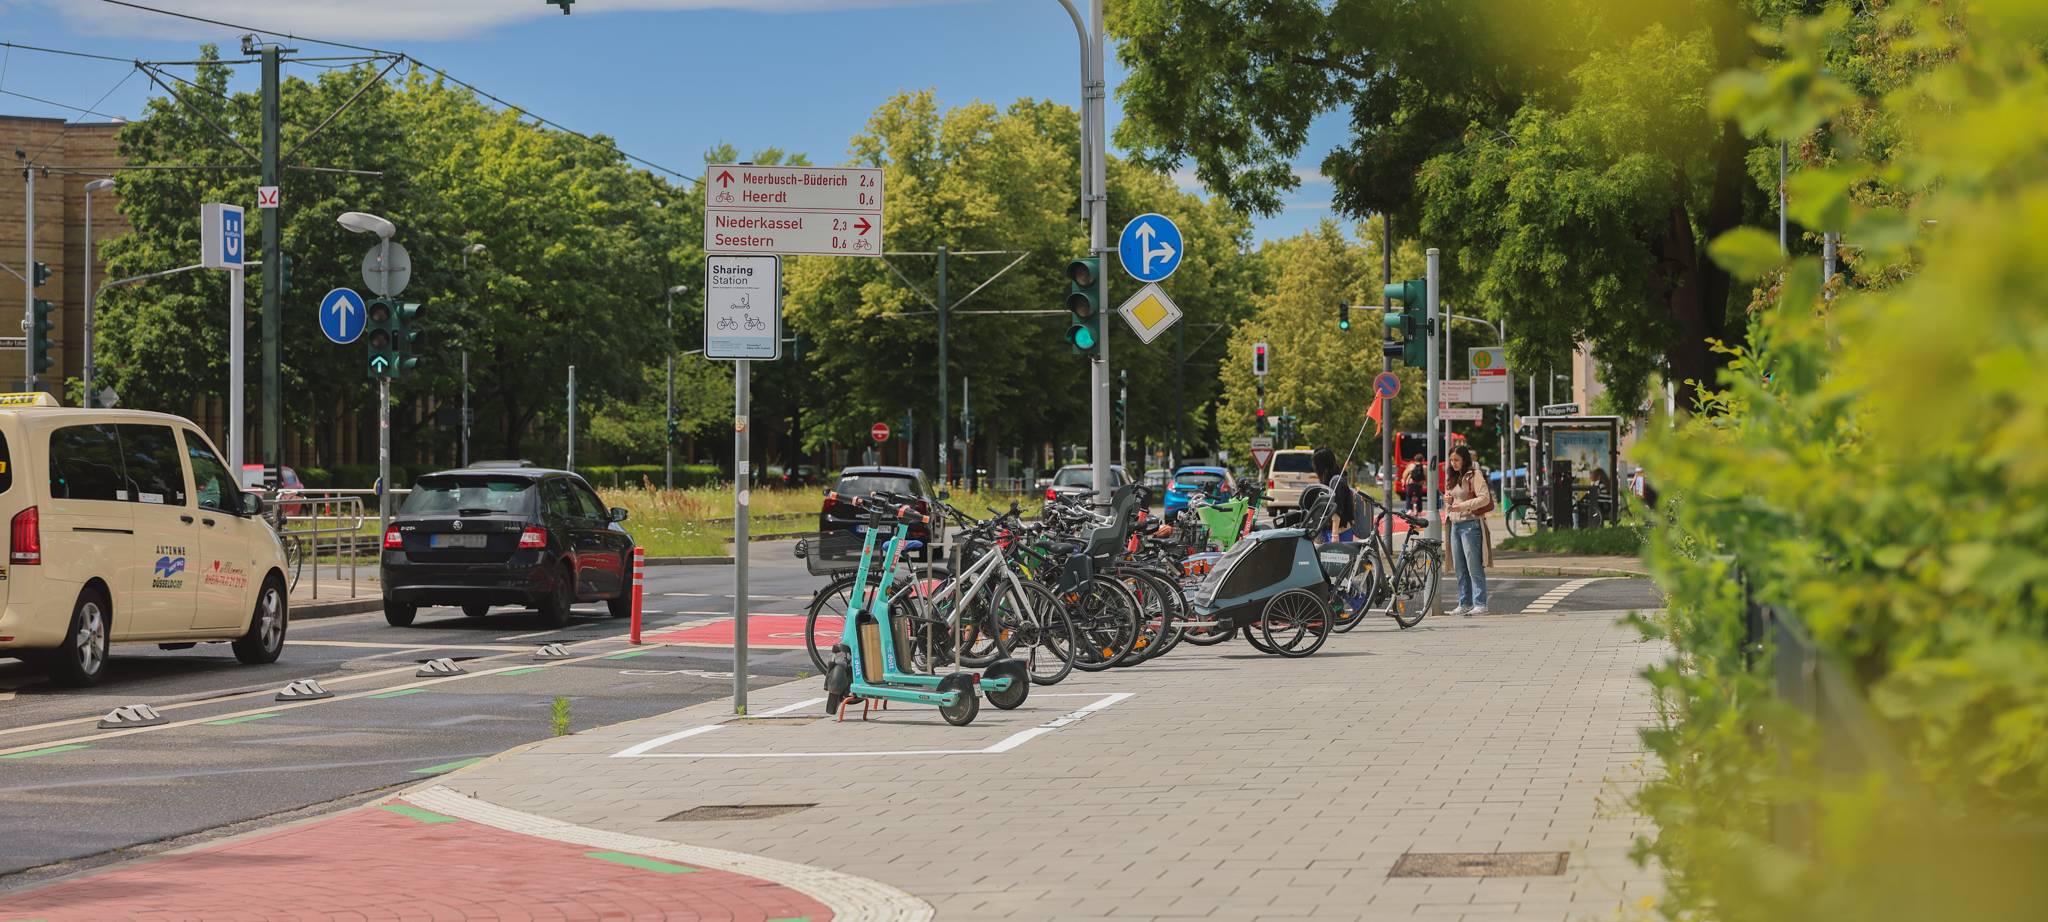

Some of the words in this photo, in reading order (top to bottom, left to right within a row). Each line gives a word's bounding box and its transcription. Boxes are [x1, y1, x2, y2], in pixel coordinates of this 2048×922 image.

[743, 172, 848, 187] Meerbusch-Büderich
[860, 174, 875, 187] 2,6
[742, 190, 787, 203] Heerdt
[859, 192, 874, 205] 0,6
[715, 215, 803, 230] Niederkassel
[833, 218, 847, 231] 2,3
[715, 233, 774, 247] Seestern
[832, 236, 847, 249] 0,6
[712, 265, 753, 276] Sharing
[712, 275, 748, 285] Station
[156, 545, 186, 556] ANTENNE
[152, 576, 183, 589] DÜSSELDORF
